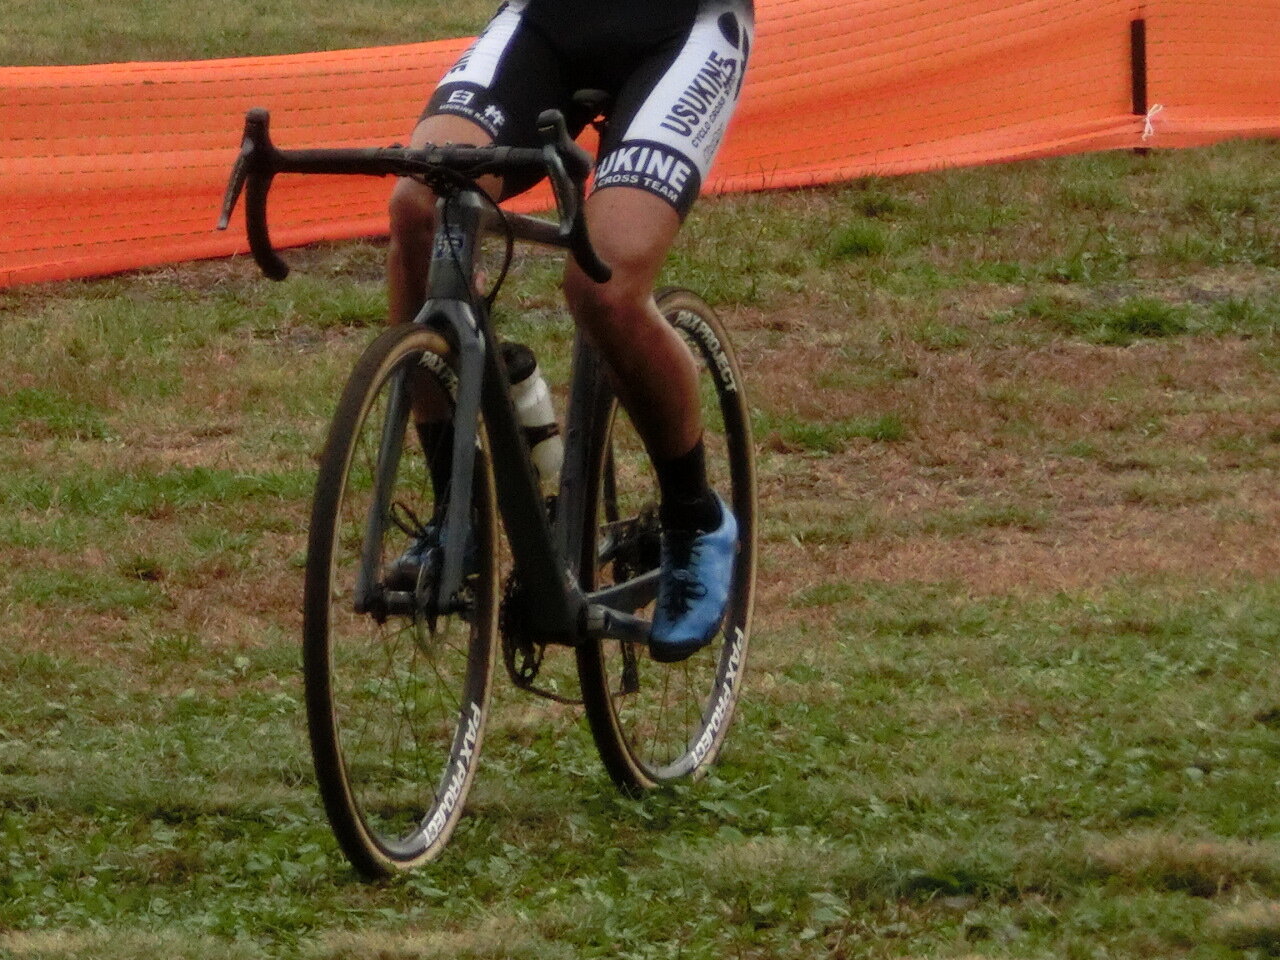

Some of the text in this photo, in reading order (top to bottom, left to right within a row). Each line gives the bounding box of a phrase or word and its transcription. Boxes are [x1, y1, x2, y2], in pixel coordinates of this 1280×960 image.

[659, 50, 726, 138] USUKINE
[598, 174, 680, 203] CROSS TEAM
[690, 626, 745, 769] PAX PROJECT
[422, 701, 482, 849] PAX PROJECT
